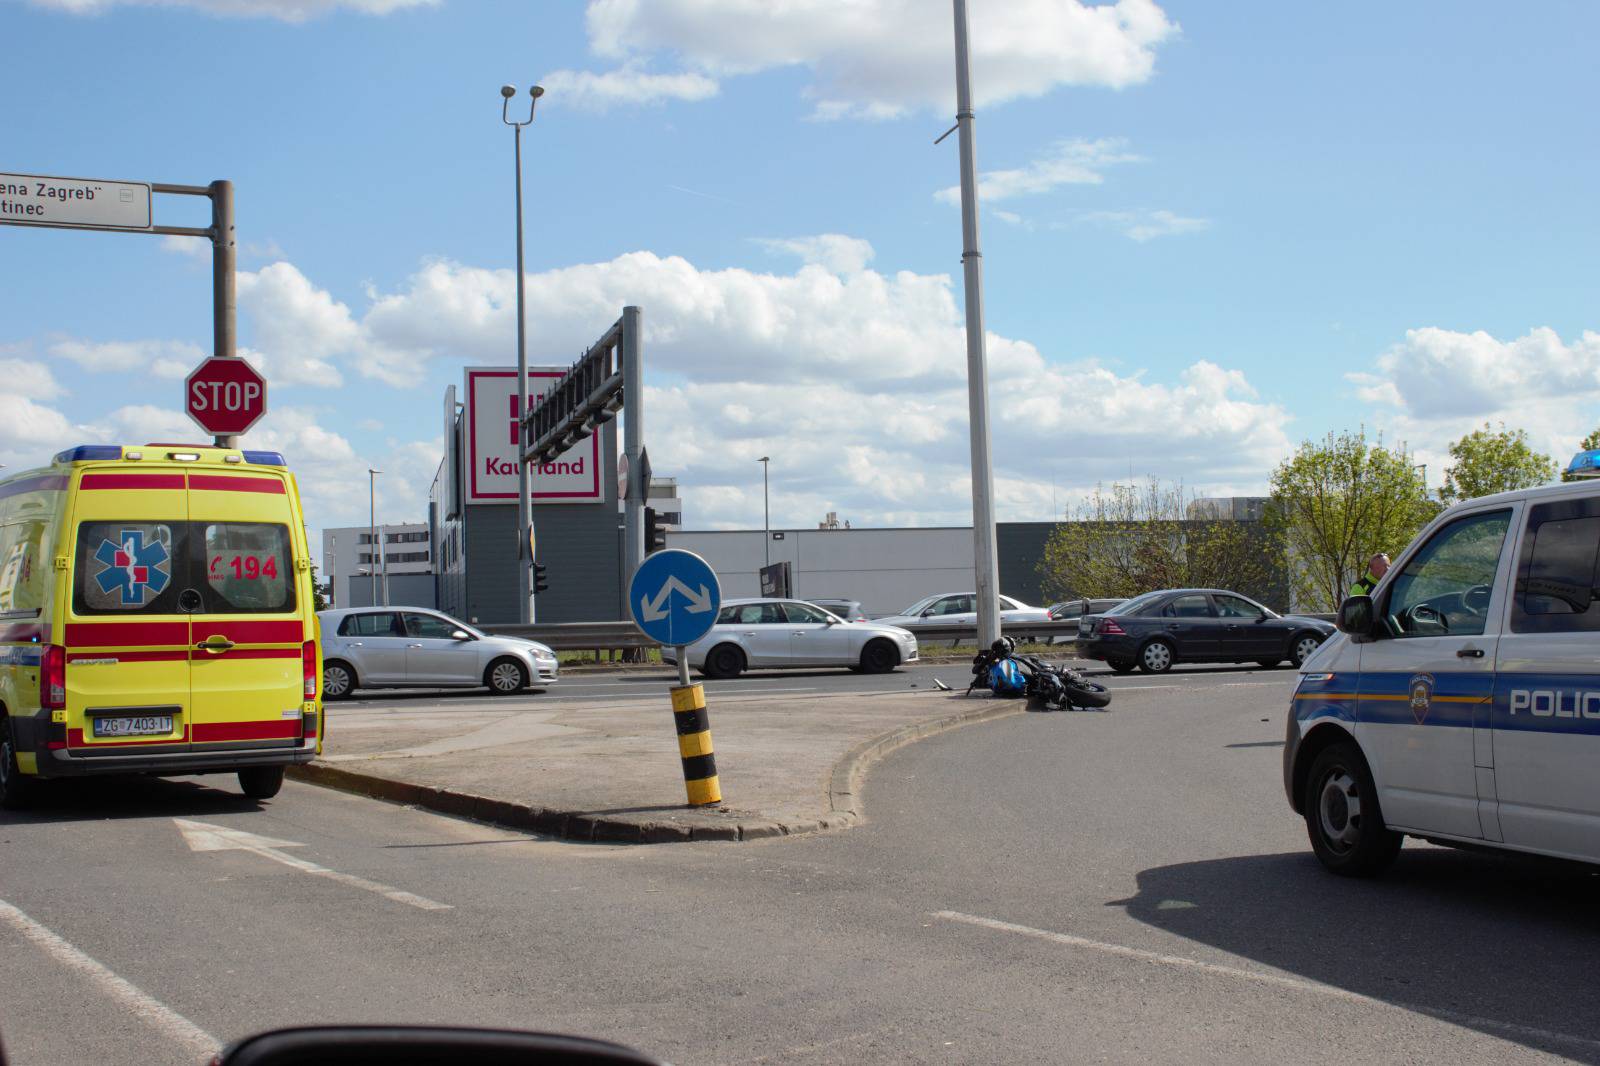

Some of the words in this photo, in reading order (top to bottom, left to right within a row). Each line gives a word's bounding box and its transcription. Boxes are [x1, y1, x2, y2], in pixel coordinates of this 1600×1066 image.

[1, 199, 45, 216] tinec
[192, 381, 260, 411] STOP
[229, 556, 277, 580] 194
[1510, 690, 1600, 719] POLIC
[103, 719, 119, 732] ZG
